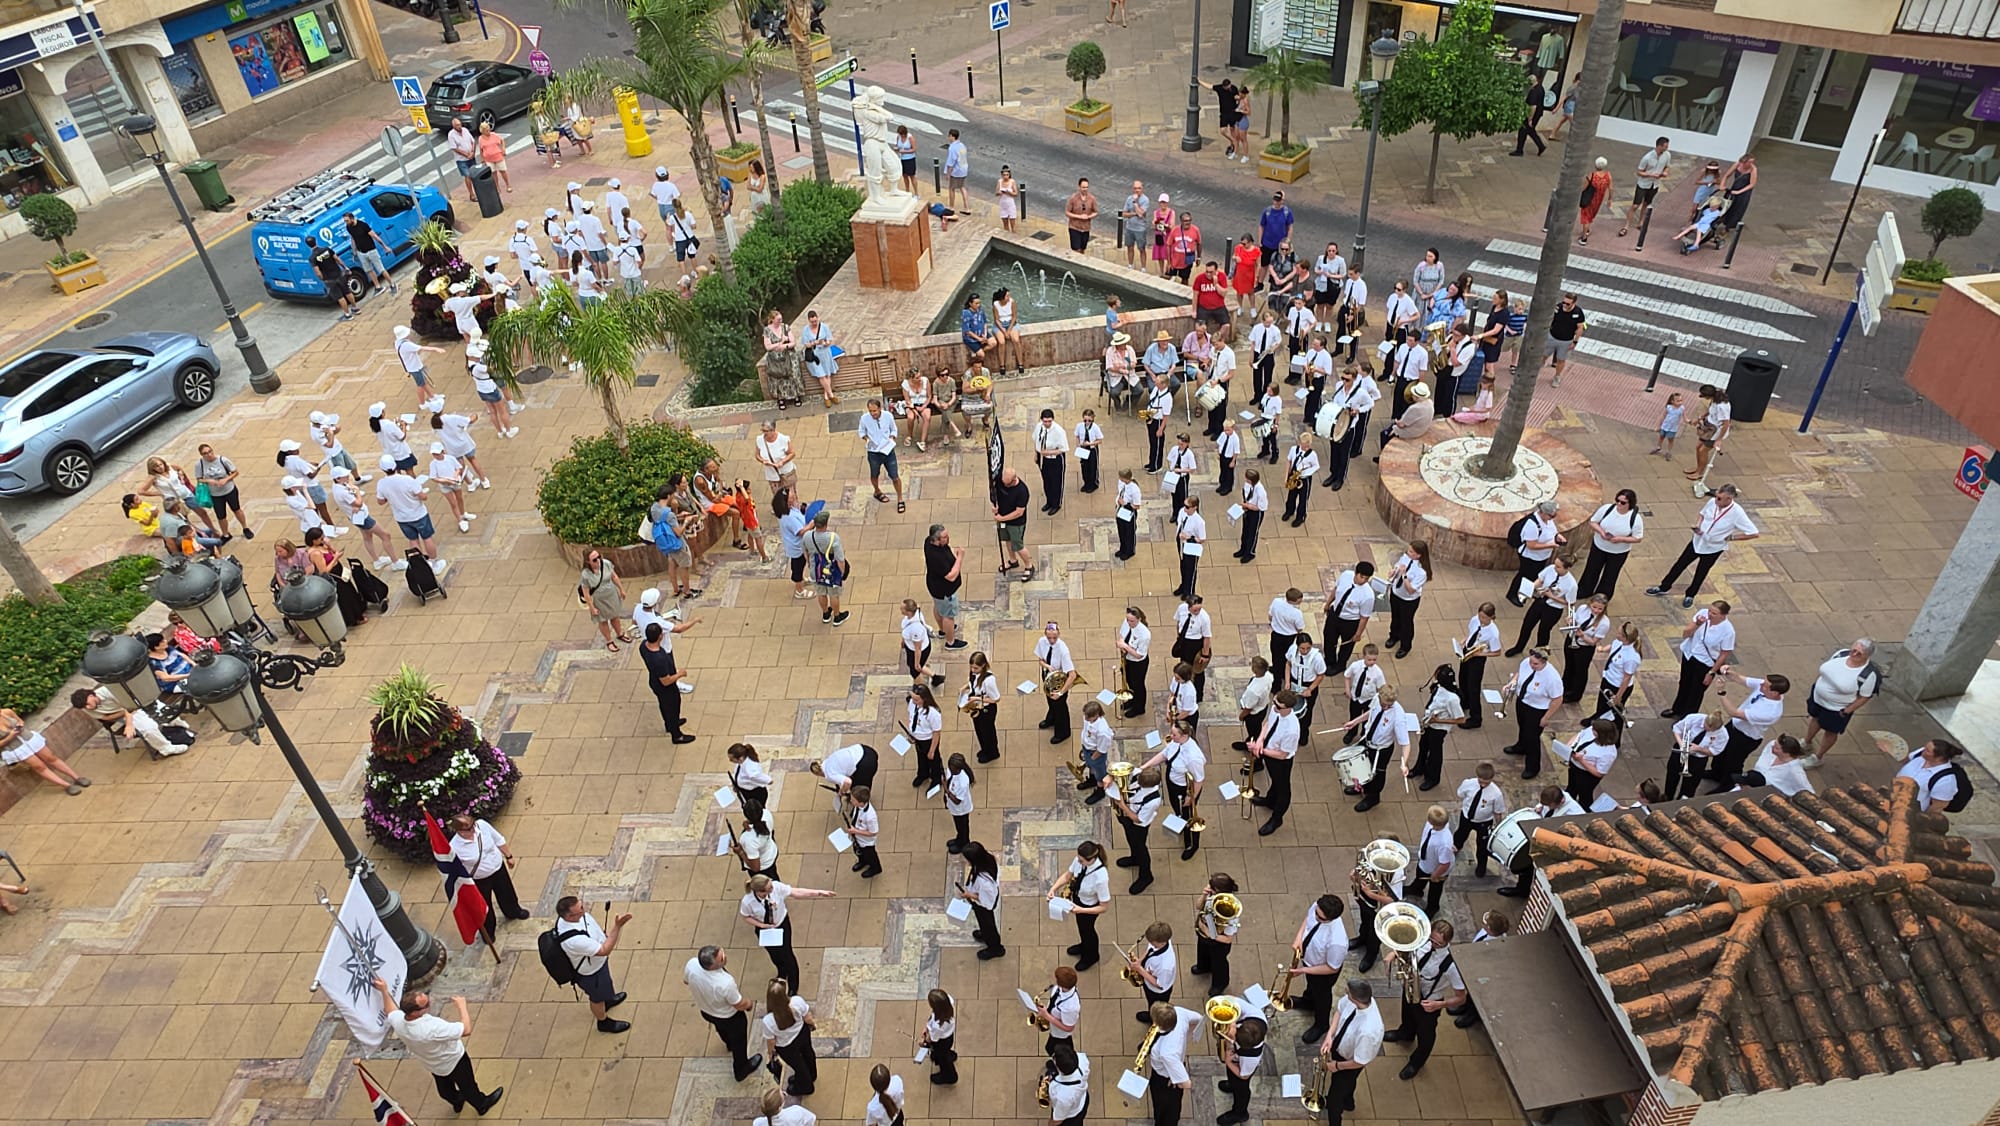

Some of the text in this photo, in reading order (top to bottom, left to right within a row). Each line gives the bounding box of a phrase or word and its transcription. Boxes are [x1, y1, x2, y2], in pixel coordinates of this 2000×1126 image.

[40, 33, 65, 44] FISCAL
[40, 39, 74, 55] SEGUROS
[532, 60, 549, 68] STOP
[1961, 455, 1983, 485] 6
[1954, 478, 1971, 491] EURO
